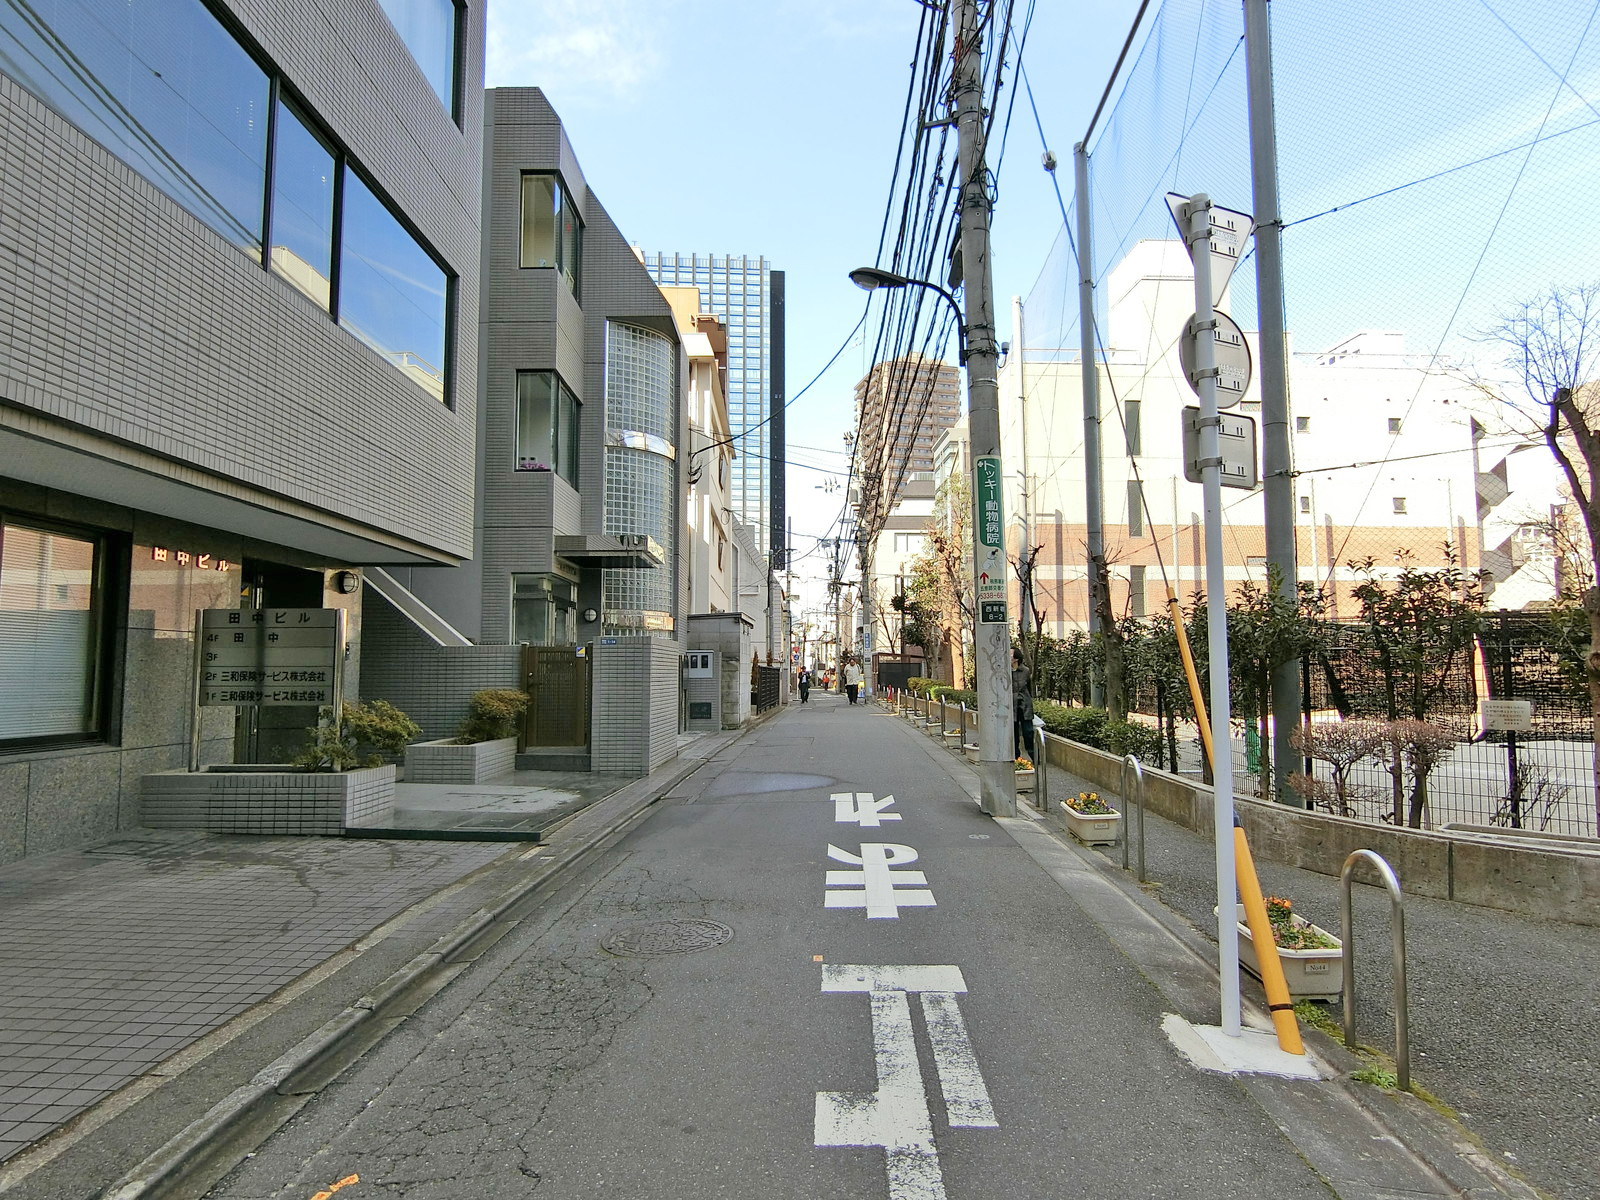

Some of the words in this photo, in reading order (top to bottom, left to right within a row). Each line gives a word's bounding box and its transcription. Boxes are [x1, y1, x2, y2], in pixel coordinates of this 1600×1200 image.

[152, 547, 229, 571] 田中ビル
[228, 611, 311, 624] 田中ビル
[206, 633, 219, 642] 4F
[206, 652, 218, 661] 3F
[205, 671, 217, 681] 2F
[221, 670, 326, 682] 三和保険サービス株式会社
[205, 691, 217, 701] 1F
[220, 690, 325, 701] 三和保険サービス株式会社
